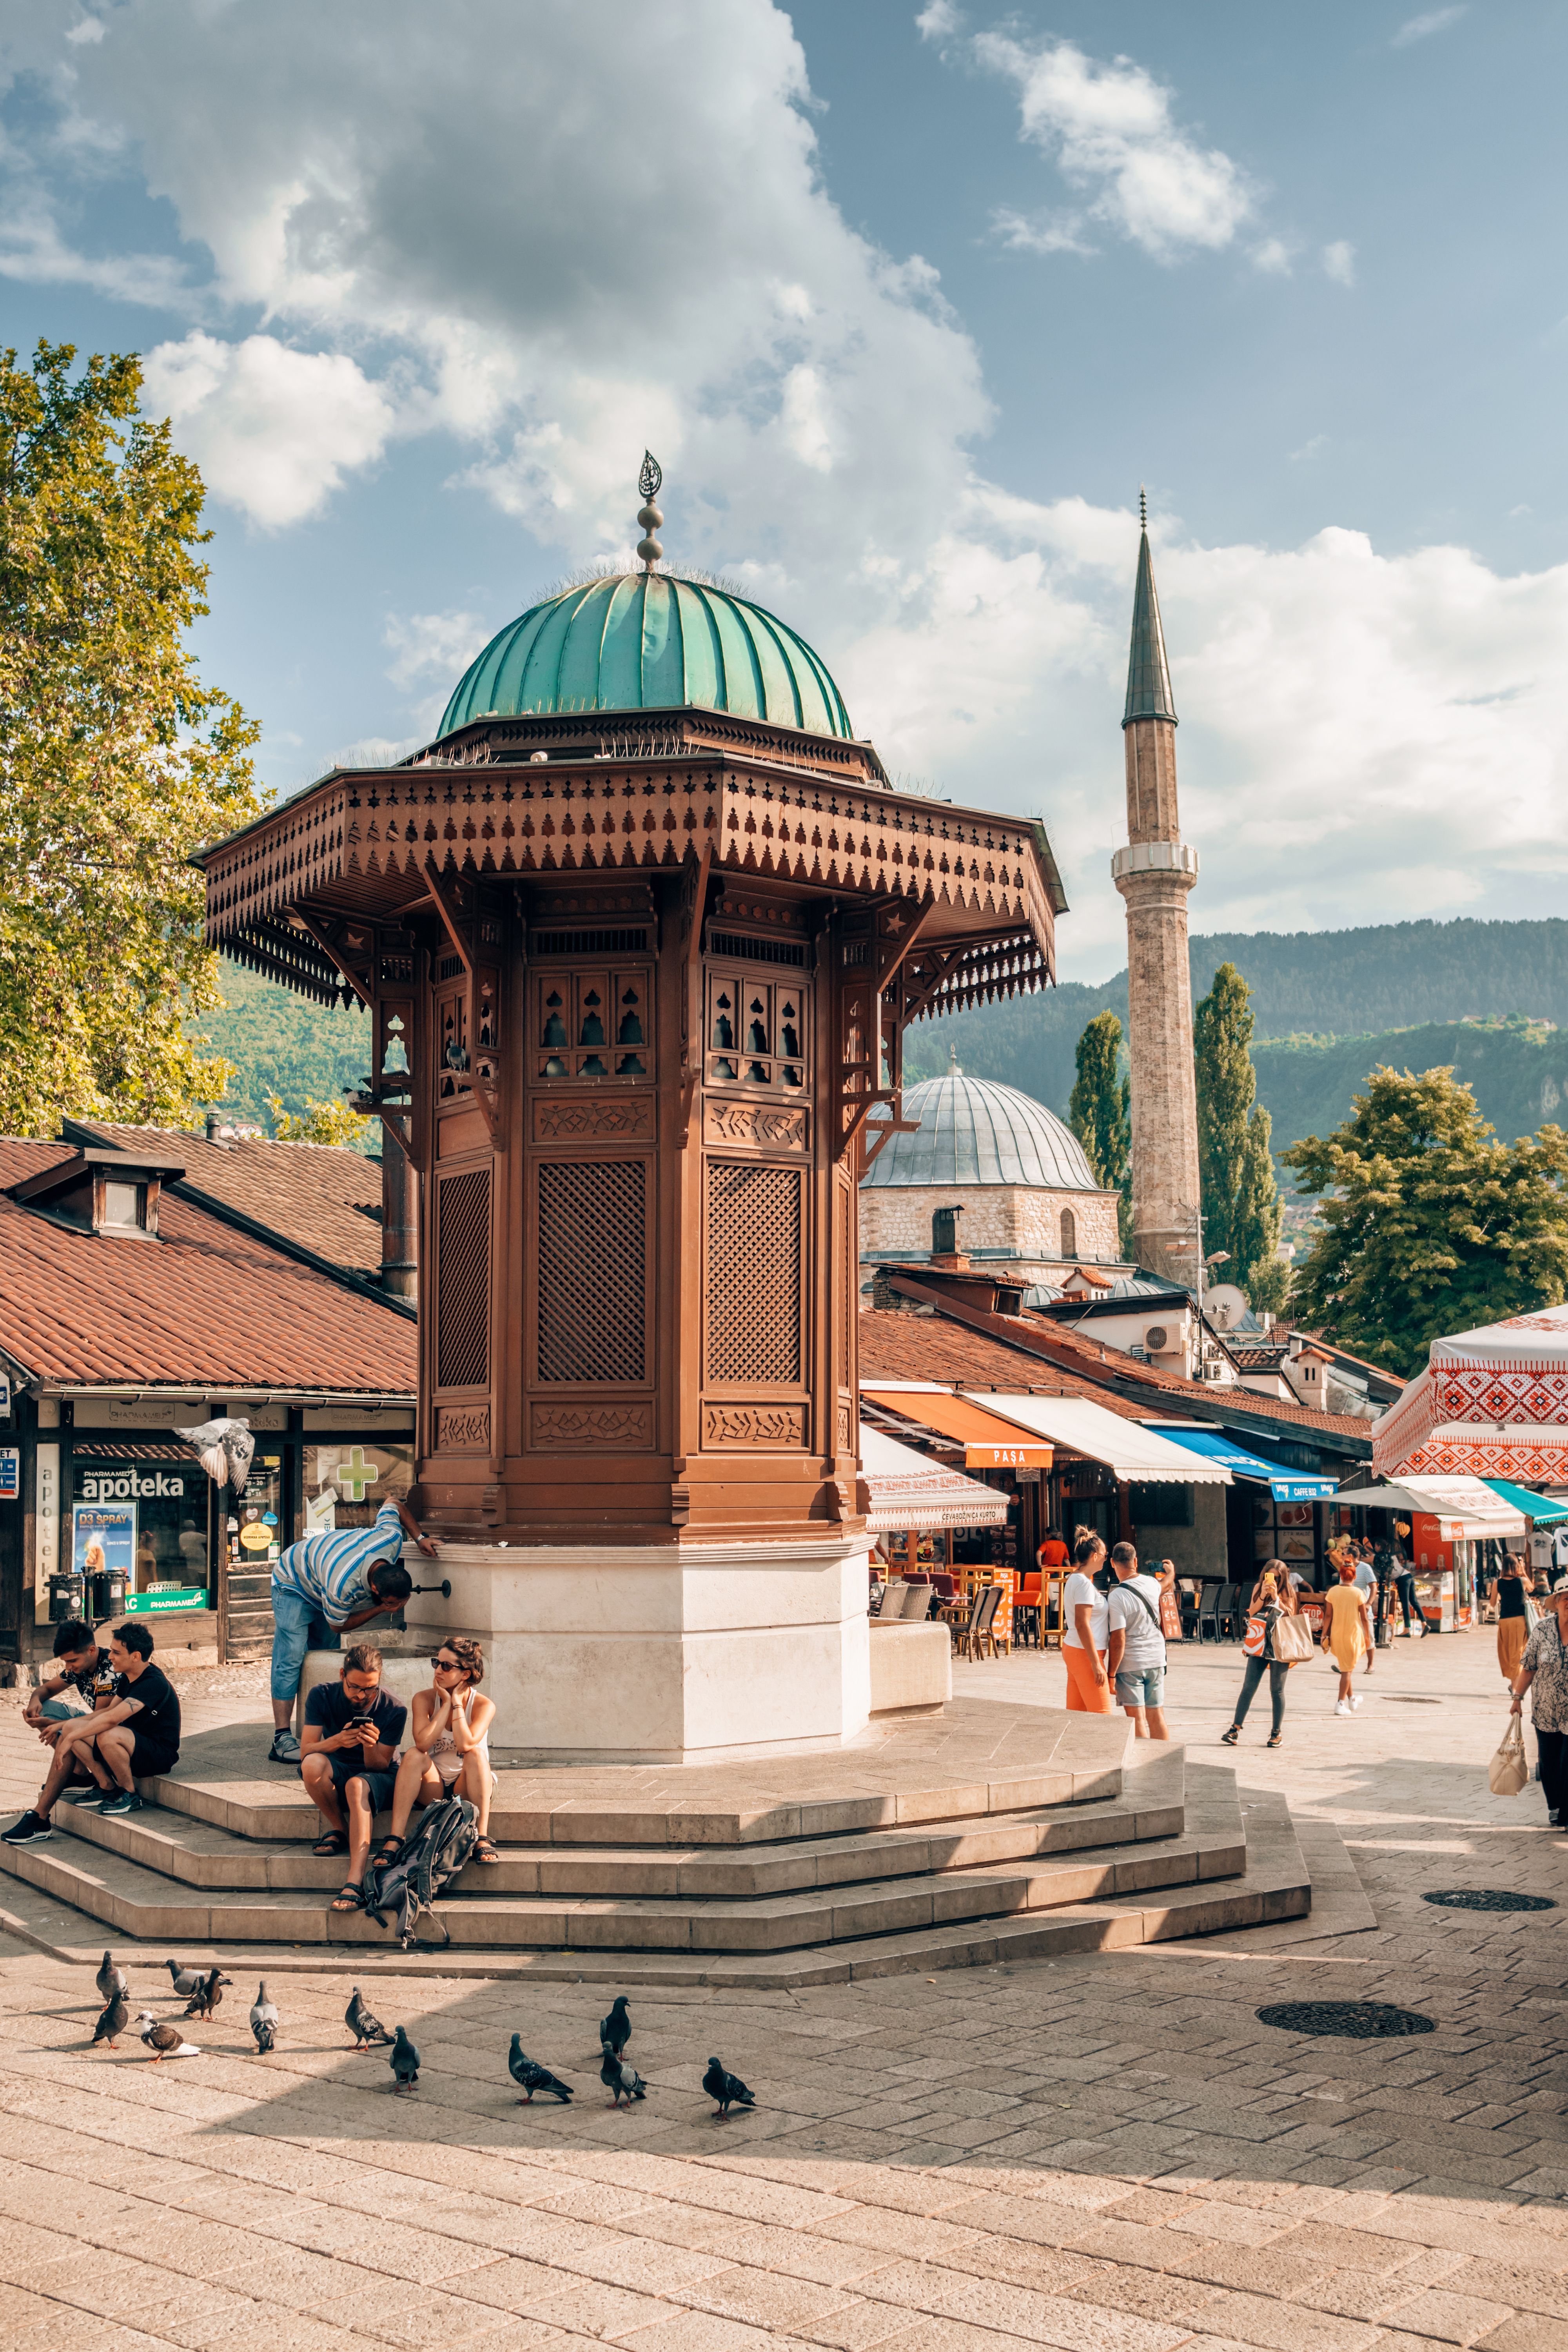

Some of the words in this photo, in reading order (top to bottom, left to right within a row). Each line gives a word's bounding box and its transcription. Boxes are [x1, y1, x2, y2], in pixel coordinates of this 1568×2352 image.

[249, 1417, 278, 1427] oteka
[0, 1450, 11, 1458] ET
[994, 1450, 1025, 1465] PAŞA
[83, 1472, 183, 1503] apoteka
[1294, 1487, 1308, 1496] CAFFE
[1308, 1488, 1317, 1496] B32
[79, 1514, 94, 1524] D3
[96, 1514, 127, 1524] SPRAY
[942, 1512, 978, 1520] ĆEVABDŽINICA
[151, 1599, 197, 1608] PHARMAMED
[1302, 1608, 1321, 1618] STOP
